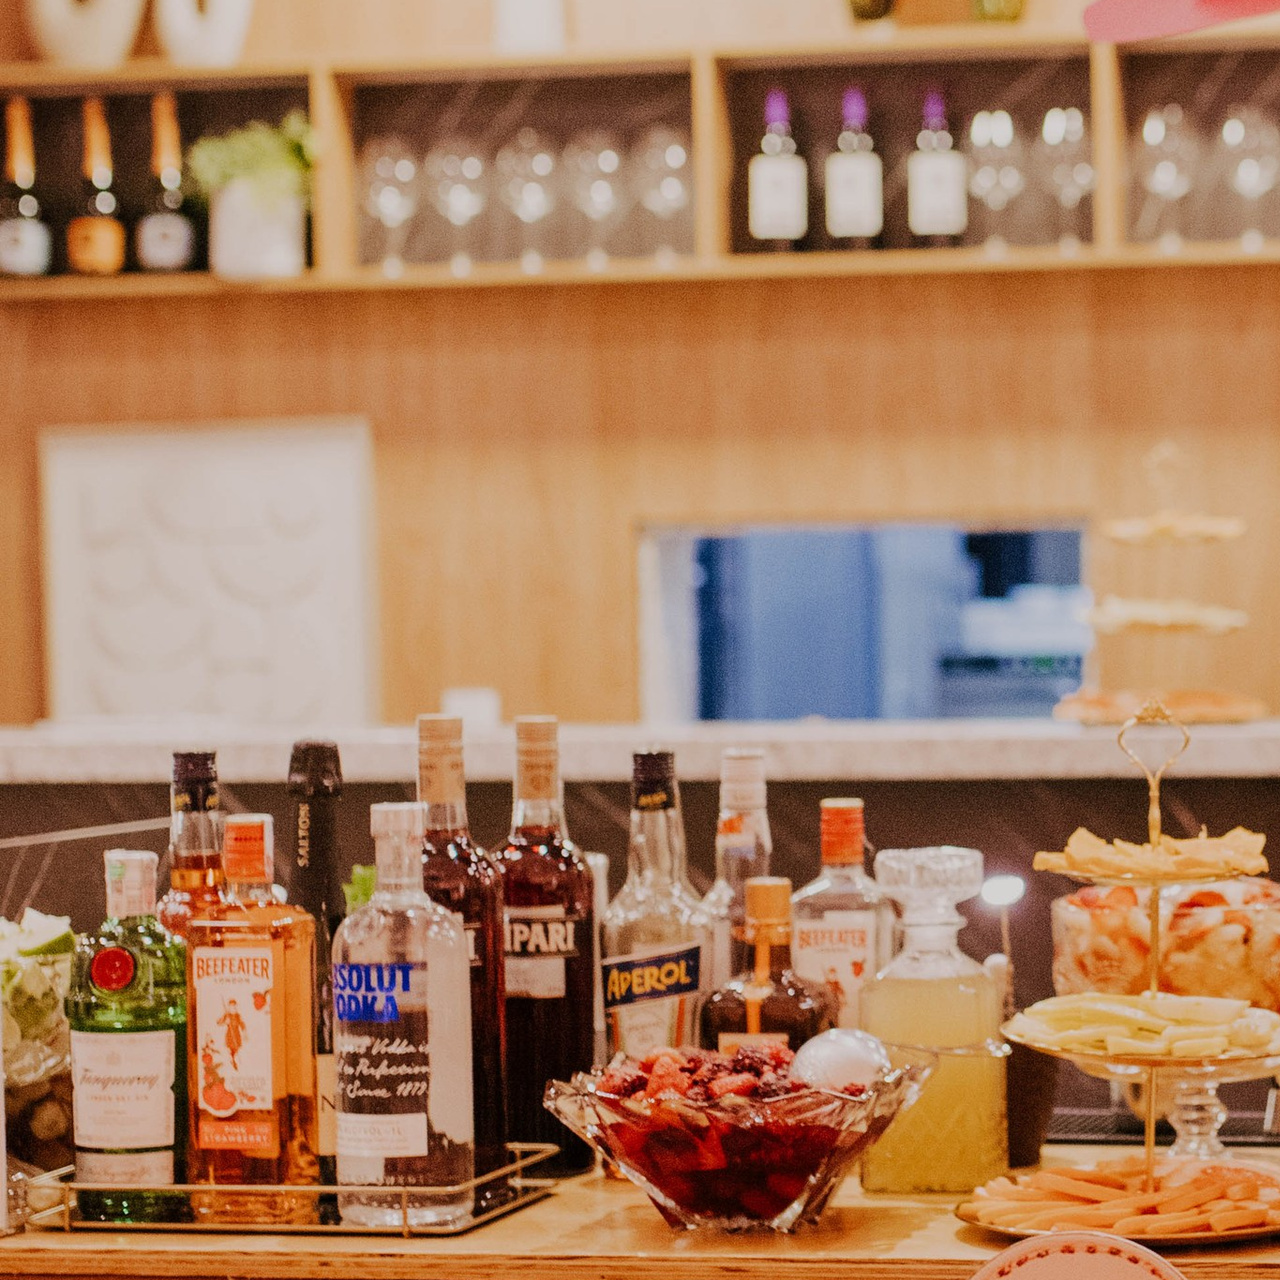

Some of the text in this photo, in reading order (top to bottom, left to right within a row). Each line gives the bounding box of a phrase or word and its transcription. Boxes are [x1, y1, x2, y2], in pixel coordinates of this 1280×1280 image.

[297, 803, 310, 867] SALTON
[504, 921, 576, 953] PARI
[196, 956, 270, 980] BEEFEATER
[606, 960, 692, 1001] APEROL
[336, 993, 400, 1023] ODKA
